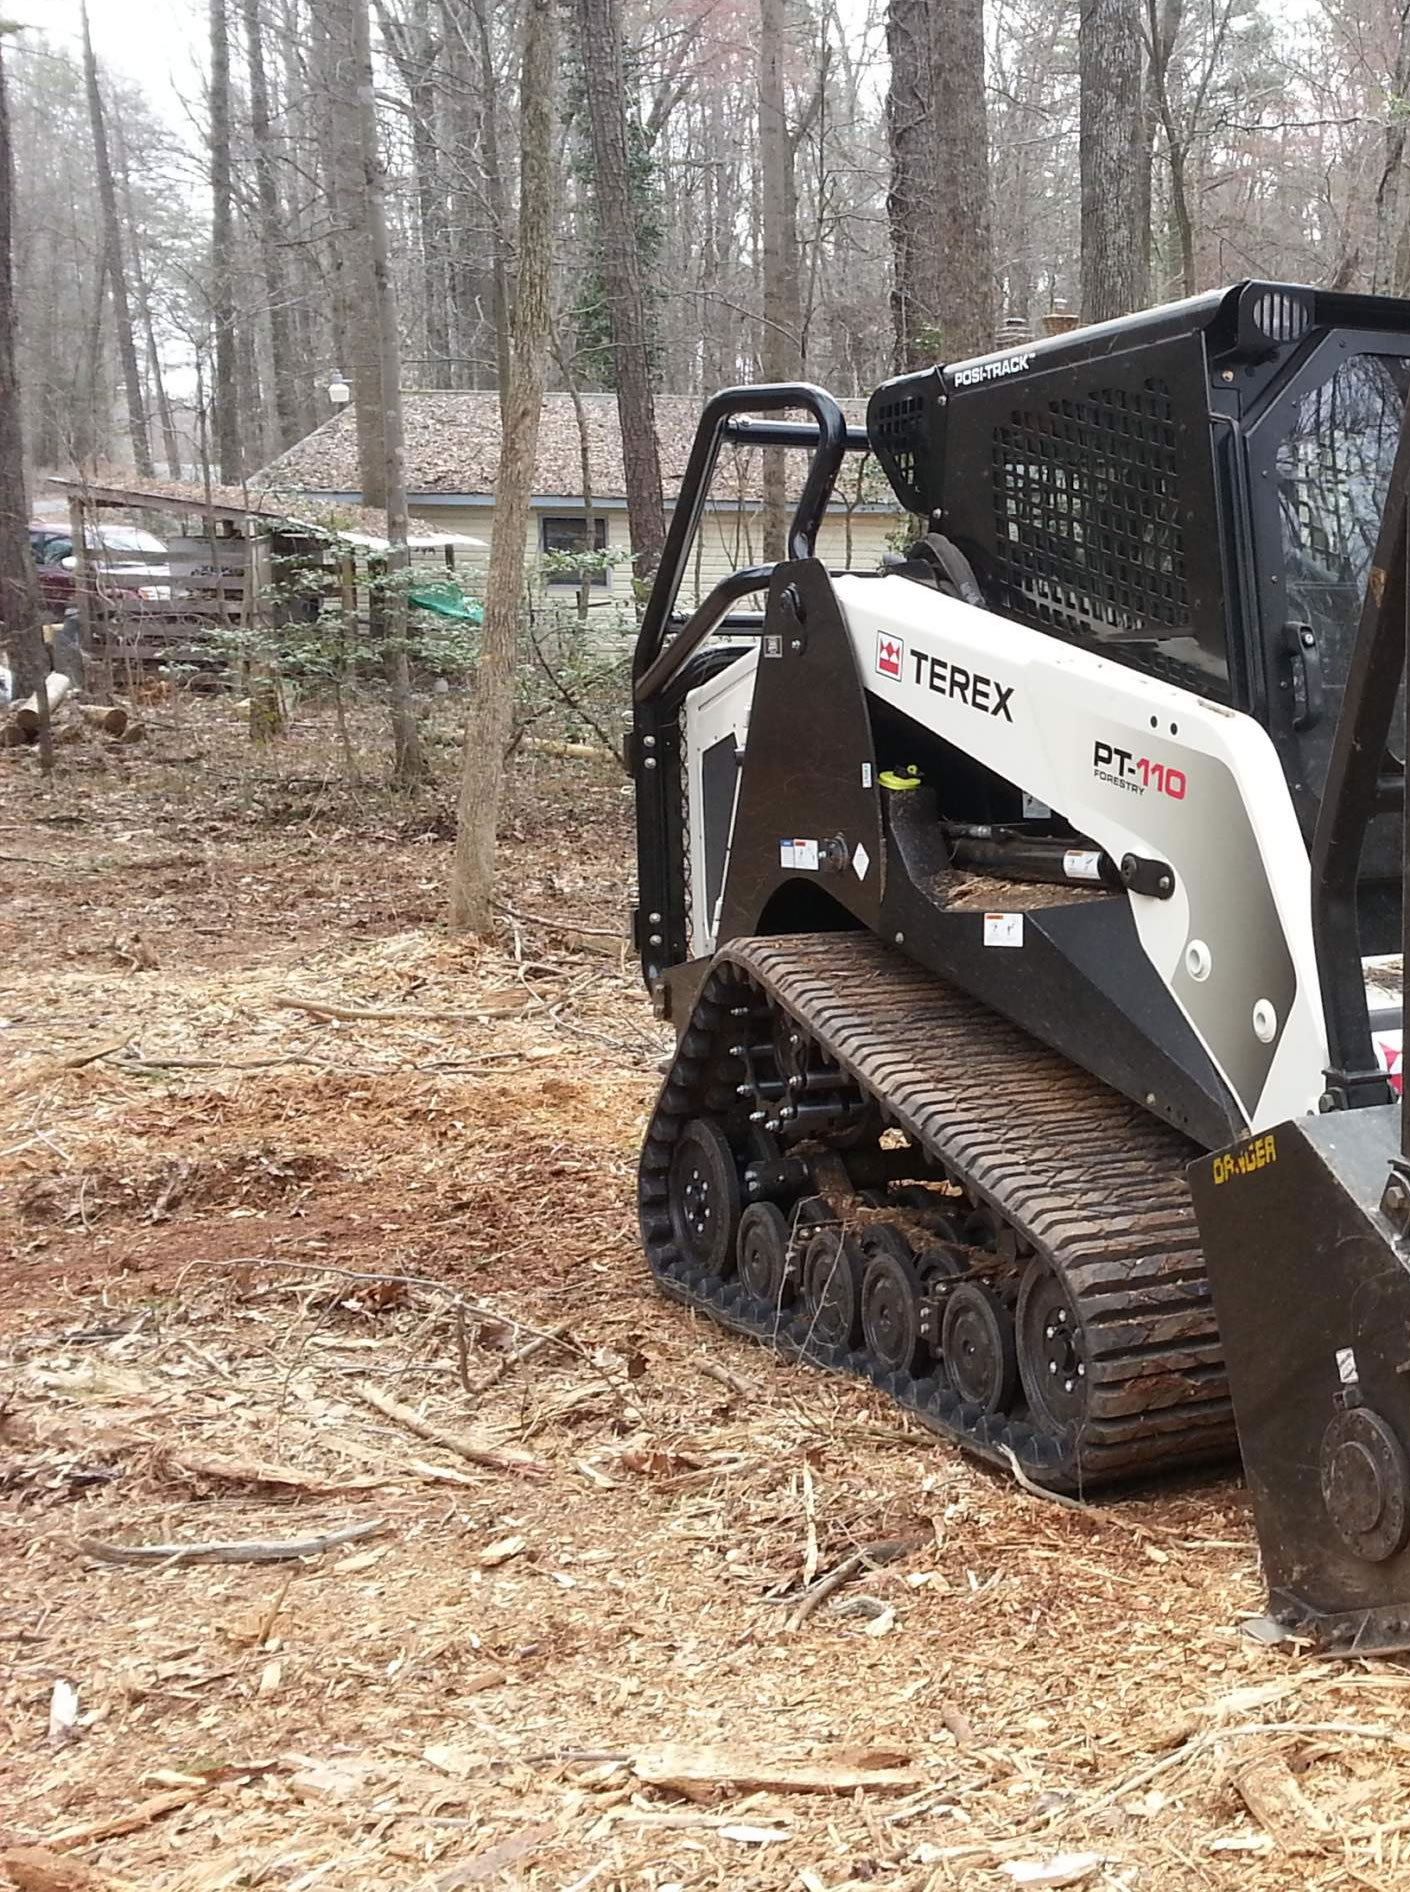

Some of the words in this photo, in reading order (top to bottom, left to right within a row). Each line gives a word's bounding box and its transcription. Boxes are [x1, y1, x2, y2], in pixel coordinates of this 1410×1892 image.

[910, 649, 1015, 723] TEREX
[1093, 741, 1186, 800] PT-110
[1093, 769, 1145, 796] FORESTRY
